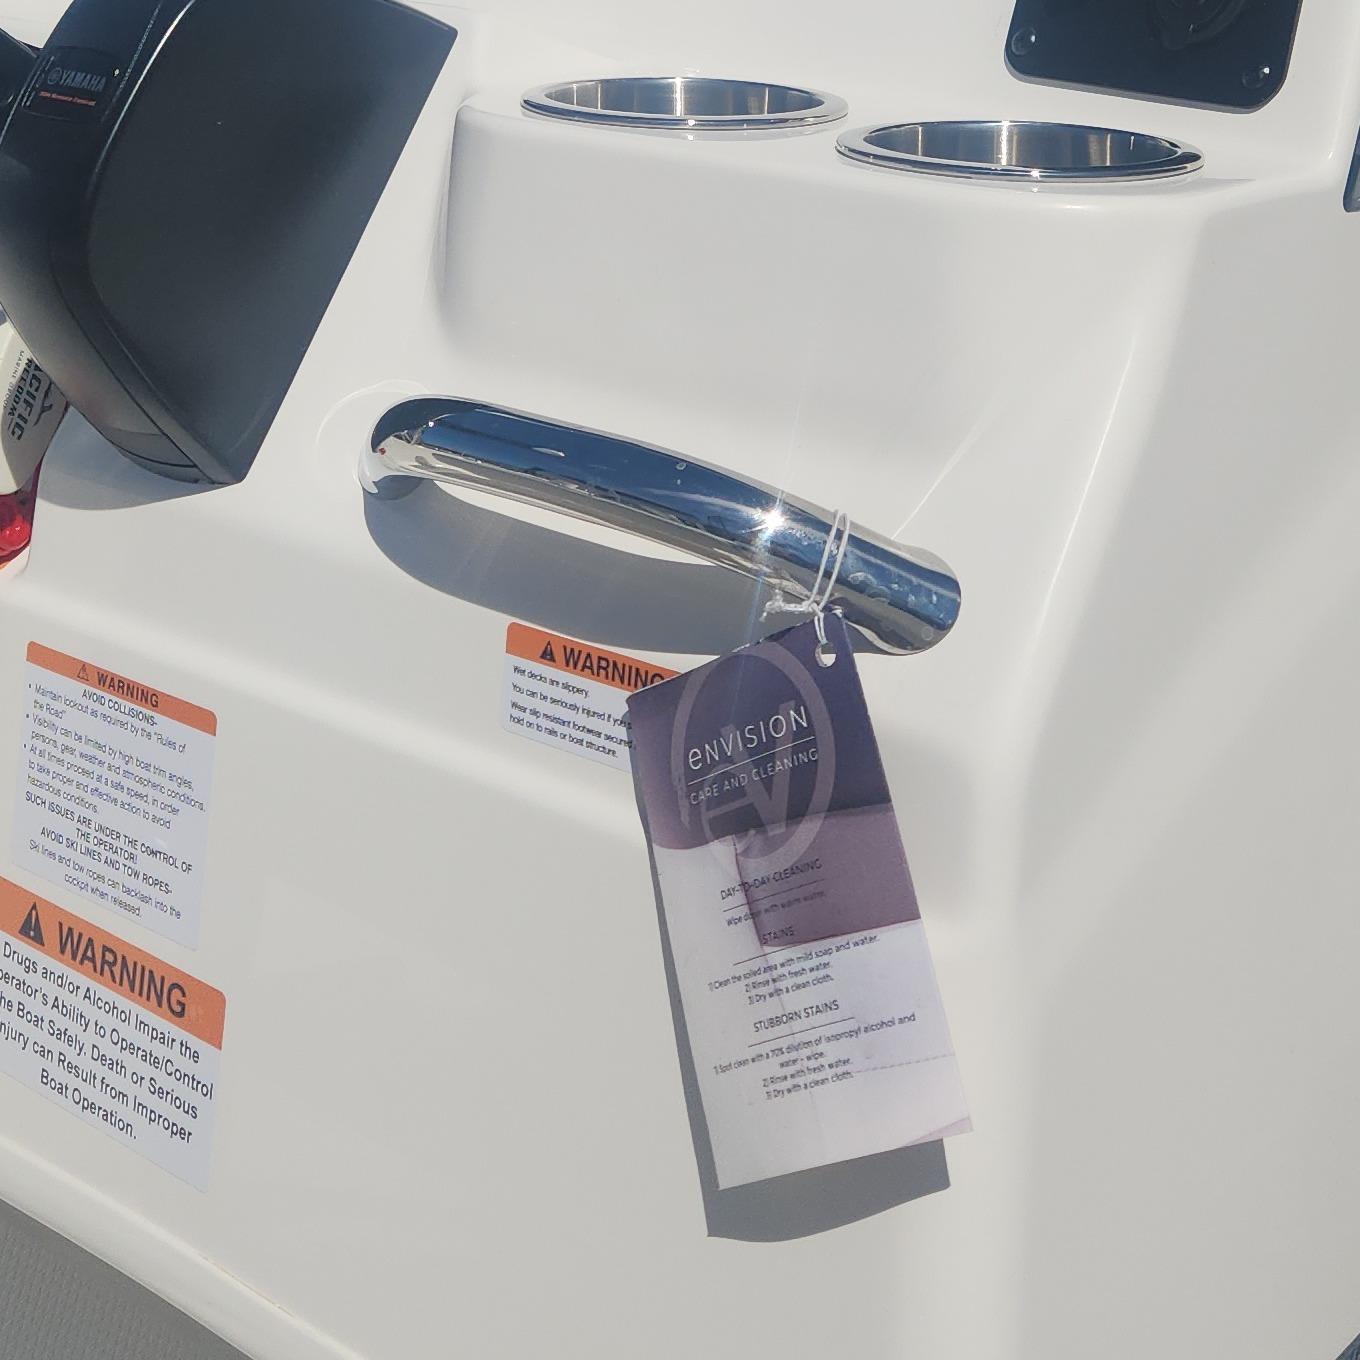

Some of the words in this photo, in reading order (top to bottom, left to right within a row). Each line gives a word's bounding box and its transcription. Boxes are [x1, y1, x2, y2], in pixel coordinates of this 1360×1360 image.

[58, 70, 106, 92] YAMAHA
[11, 364, 44, 440] ACIFIC
[81, 687, 105, 706] AVOID
[96, 670, 160, 708] WARNING
[689, 782, 718, 806] CARE
[723, 772, 749, 795] AND
[752, 747, 820, 780] CLEANING
[25, 790, 46, 808] SUCH
[47, 800, 74, 821] ISSUES
[77, 813, 91, 829] ARE
[93, 821, 120, 842] UNDER
[122, 834, 138, 849] THE
[140, 842, 179, 868] CONTROL
[180, 860, 192, 874] OF
[40, 825, 63, 845] AVOID
[65, 837, 77, 851] SKI
[79, 843, 101, 863] LINES
[103, 855, 120, 871] AND
[122, 863, 140, 880] TOW
[75, 827, 90, 843] THE
[2, 940, 38, 979] Drugs
[41, 961, 80, 999] and/or
[82, 984, 131, 1027] Alcohol
[134, 1014, 176, 1054] Impair
[179, 1038, 199, 1065] the
[58, 921, 187, 1019] WARNING
[50, 993, 90, 1034] Ability
[93, 1018, 105, 1039] to
[109, 1027, 213, 1101] Operate/Control
[753, 1008, 802, 1034] STUBBORN
[803, 998, 839, 1019] STAINS
[16, 1000, 44, 1031] Boat
[47, 1019, 87, 1059] Safely.
[91, 1043, 126, 1078] Death
[130, 1067, 144, 1089] or
[147, 1075, 198, 1120] Serious
[32, 1039, 53, 1062] can
[57, 1050, 97, 1088] Result
[100, 1076, 129, 1107] from
[132, 1094, 192, 1148] Improper
[40, 1067, 68, 1099] Boat
[71, 1085, 137, 1140] Operation.
